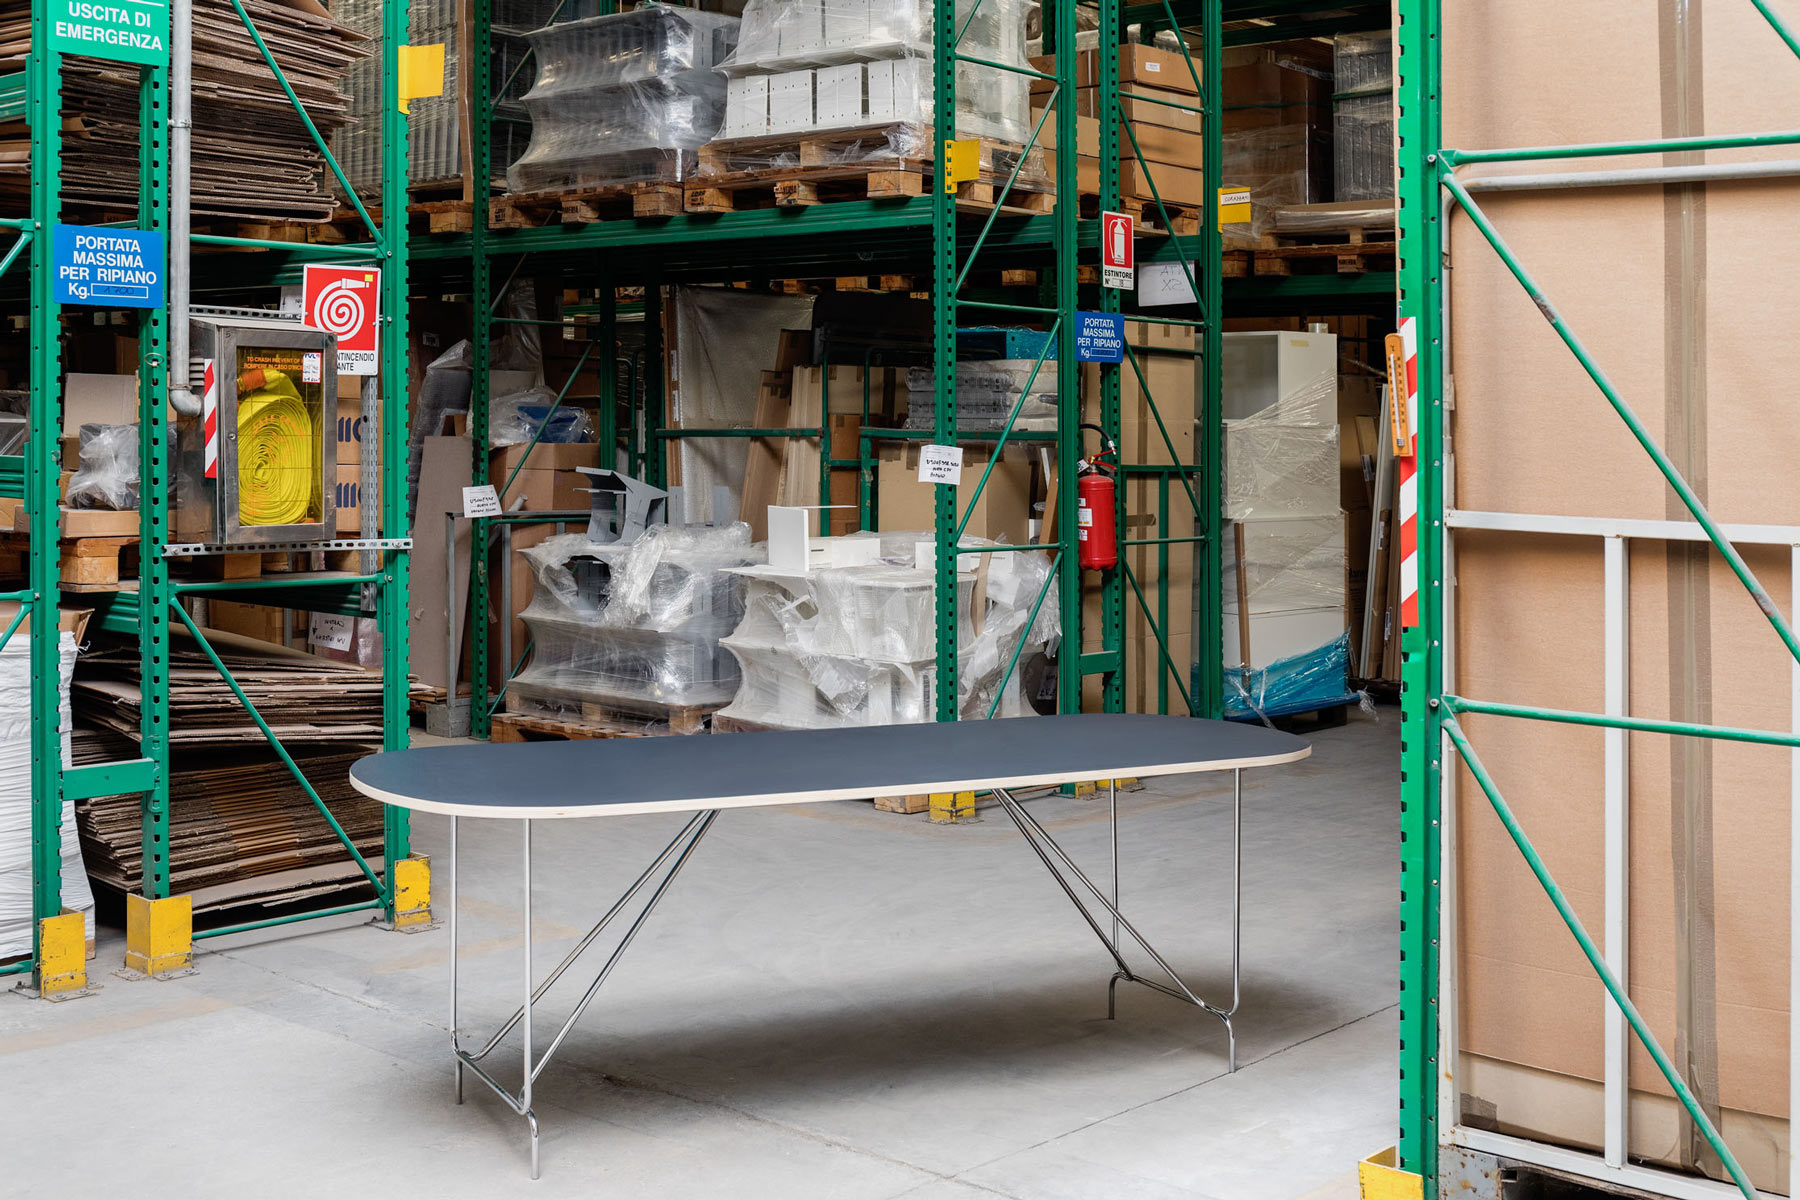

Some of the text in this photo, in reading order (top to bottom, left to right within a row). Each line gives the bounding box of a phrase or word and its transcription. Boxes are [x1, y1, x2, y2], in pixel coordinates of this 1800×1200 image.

[68, 1, 151, 28] USCITA DI
[55, 21, 163, 51] EMERGENZA
[76, 235, 141, 252] PORTATA
[73, 251, 144, 268] MASSIMA
[60, 266, 157, 285] PER RIPIANO
[1104, 269, 1133, 280] ESTINTORE
[68, 282, 90, 299] Kg.
[1084, 317, 1115, 329] PORTATA
[1083, 327, 1116, 339] MASSIMA
[1077, 337, 1121, 349] PER RIPIANO
[337, 352, 375, 362] NTINCENDIO
[337, 362, 355, 371] ANTE
